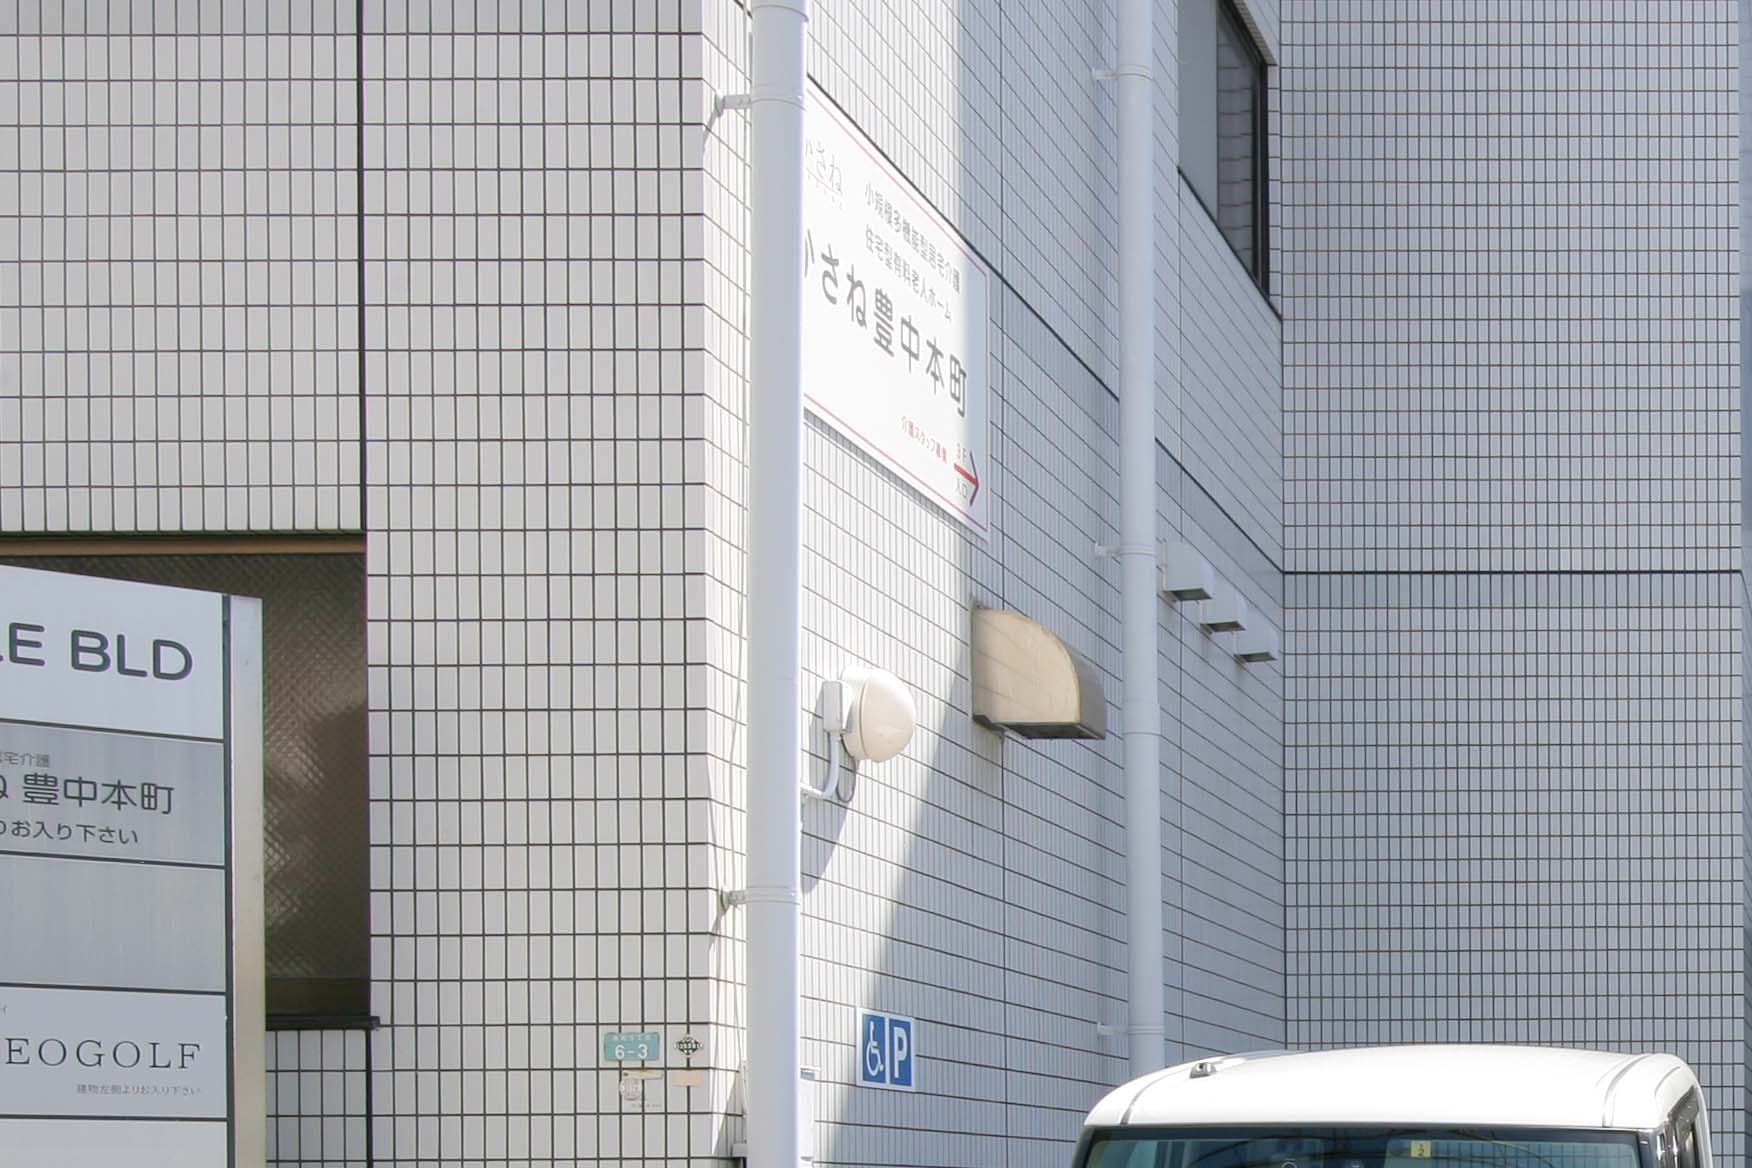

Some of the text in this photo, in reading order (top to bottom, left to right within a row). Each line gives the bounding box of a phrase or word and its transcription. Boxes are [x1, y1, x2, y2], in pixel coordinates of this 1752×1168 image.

[0, 622, 194, 681] E BLD
[0, 751, 51, 768] 宅介護
[22, 772, 176, 815] 豊中本町
[4, 1037, 202, 1069] EOGOLF
[614, 1044, 648, 1060] 6-3
[893, 1026, 909, 1078] P
